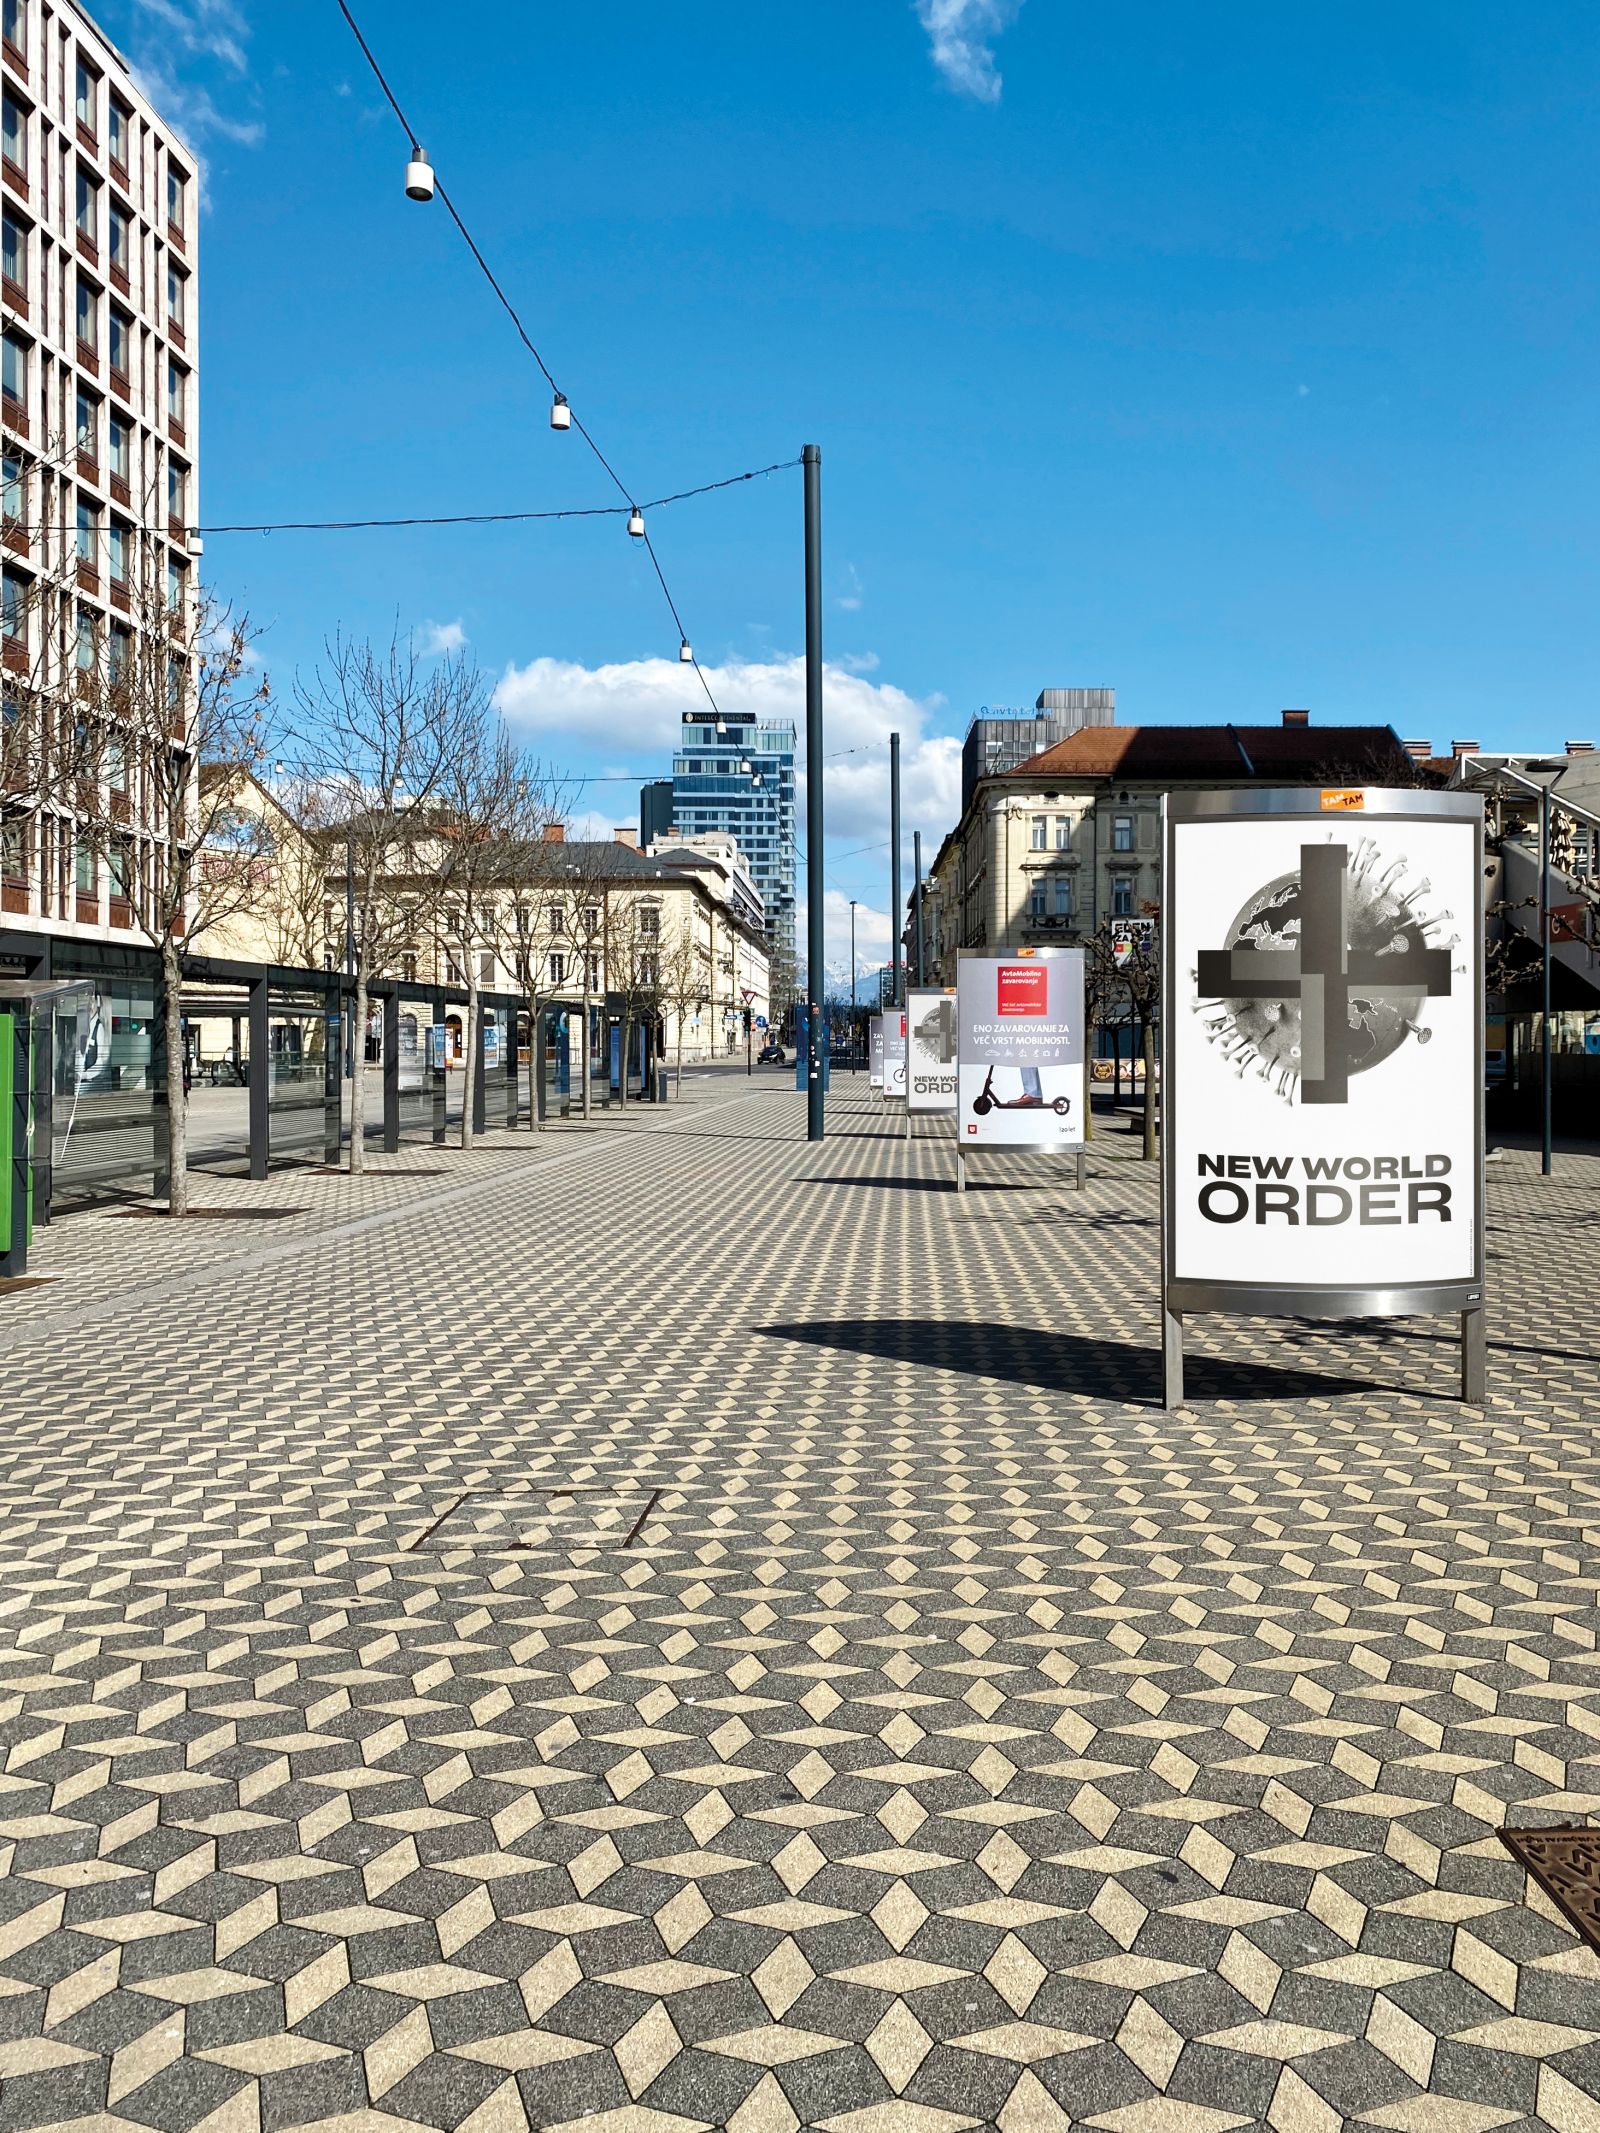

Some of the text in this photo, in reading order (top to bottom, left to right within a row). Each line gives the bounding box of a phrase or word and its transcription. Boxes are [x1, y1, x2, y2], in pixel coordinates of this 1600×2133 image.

[1323, 794, 1363, 806] TAM TAM
[994, 1025, 1057, 1033] ZAVAROVANJE
[1058, 1025, 1069, 1033] ZA
[973, 1035, 1071, 1045] VEČ VRST MOBILNOSTI.
[1198, 1154, 1452, 1181] NEW WORLD
[1198, 1181, 1452, 1225] ORDER
